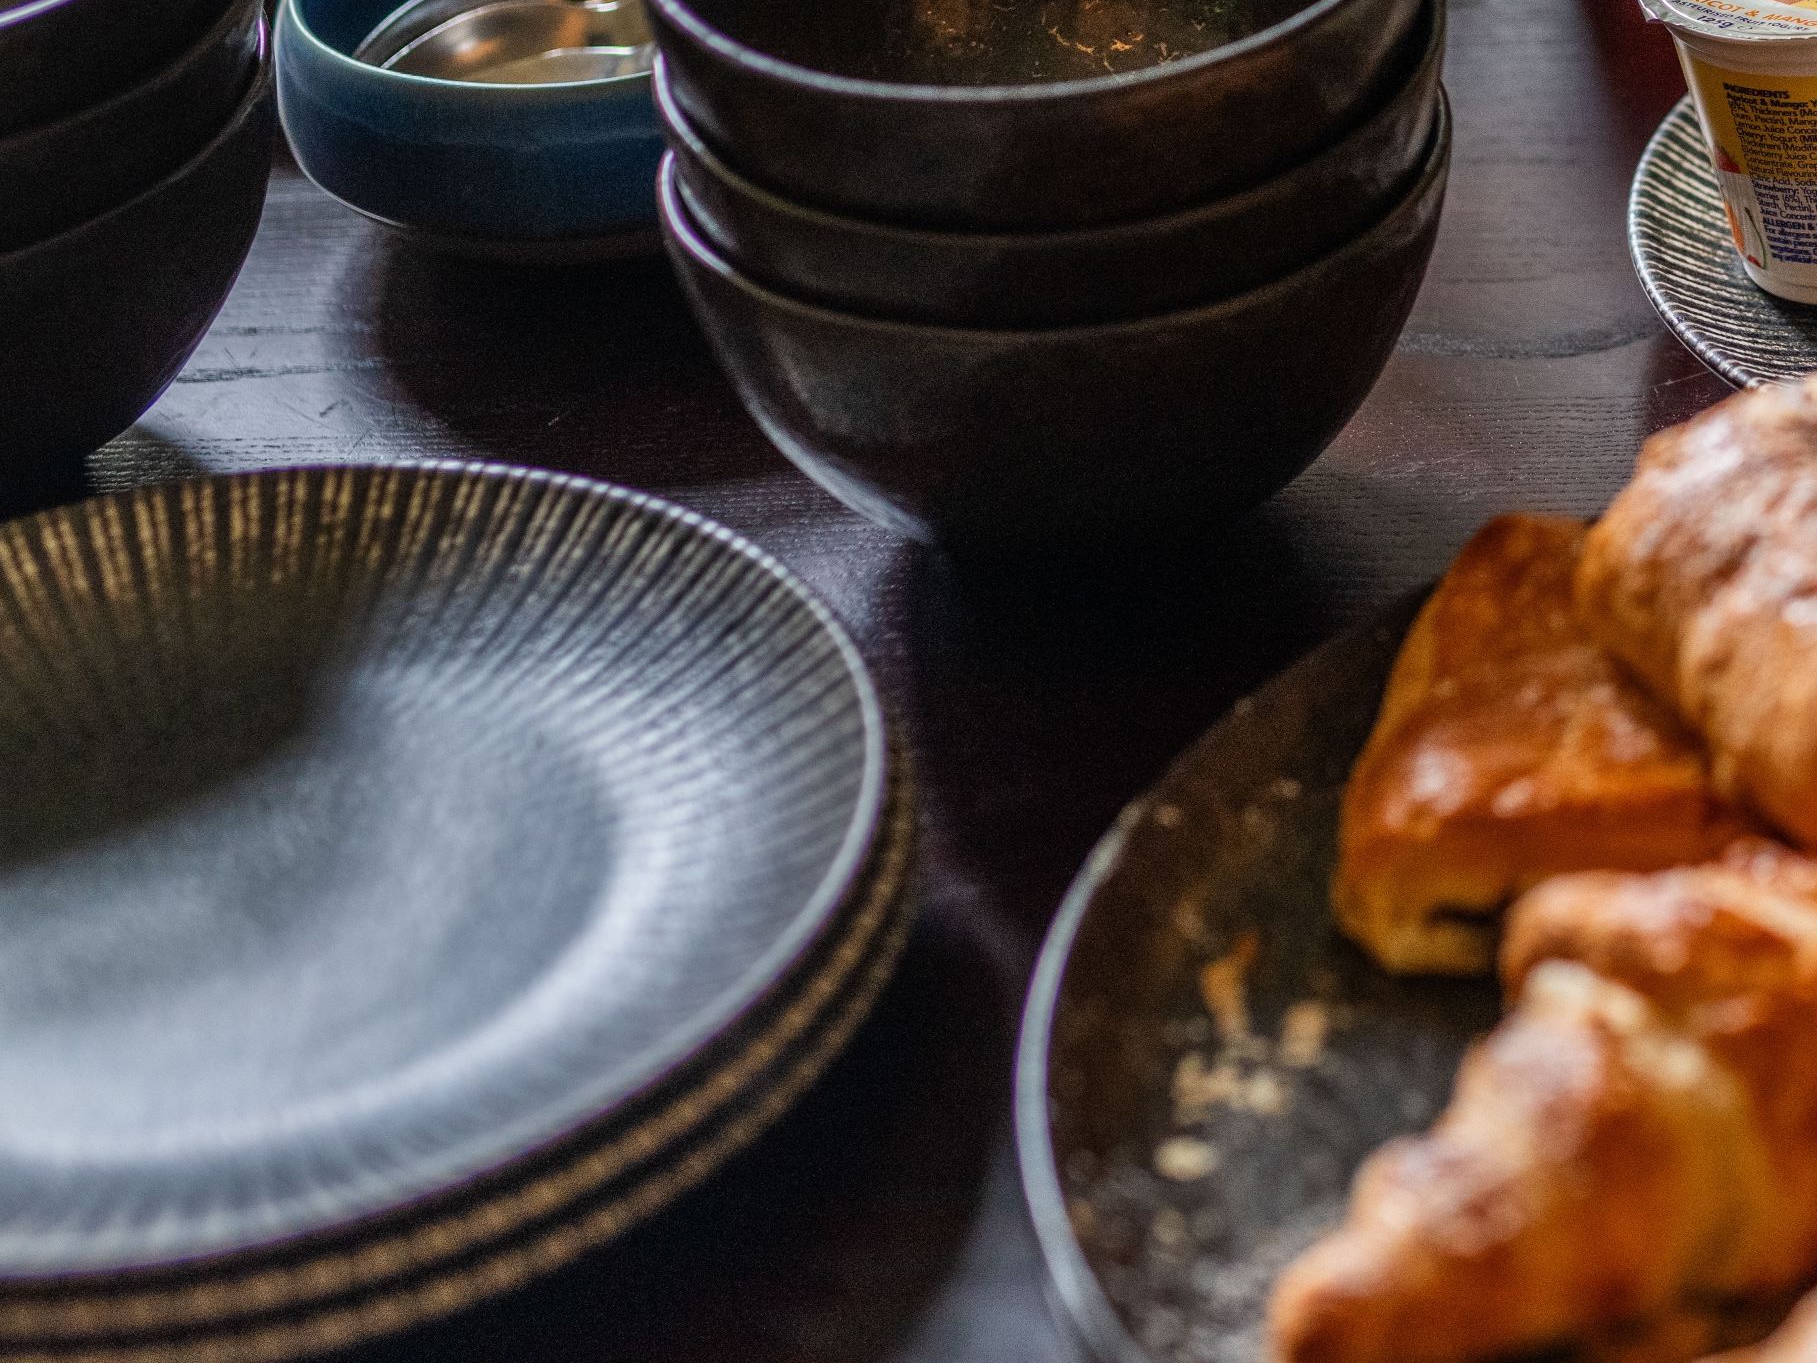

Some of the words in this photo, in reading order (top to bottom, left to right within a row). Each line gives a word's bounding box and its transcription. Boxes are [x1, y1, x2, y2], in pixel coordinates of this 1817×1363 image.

[1745, 9, 1760, 17] &
[1697, 16, 1734, 29] 125g
[1734, 16, 1766, 26] FRUIT
[1722, 82, 1790, 98] INGREDIENTS
[1759, 98, 1768, 106] &
[1770, 100, 1808, 109] Mango:
[1750, 105, 1798, 117] Thickeners
[1763, 124, 1786, 134] Juice
[1736, 127, 1767, 140] Cherry:
[1768, 134, 1799, 145] Yogurt
[1784, 151, 1808, 161] Juice
[1772, 176, 1793, 186] Acid,
[1751, 179, 1801, 197] Strawberry:
[1784, 202, 1814, 214] Pectin),
[1763, 217, 1805, 231] ALLERGEN
[1807, 223, 1815, 231] &
